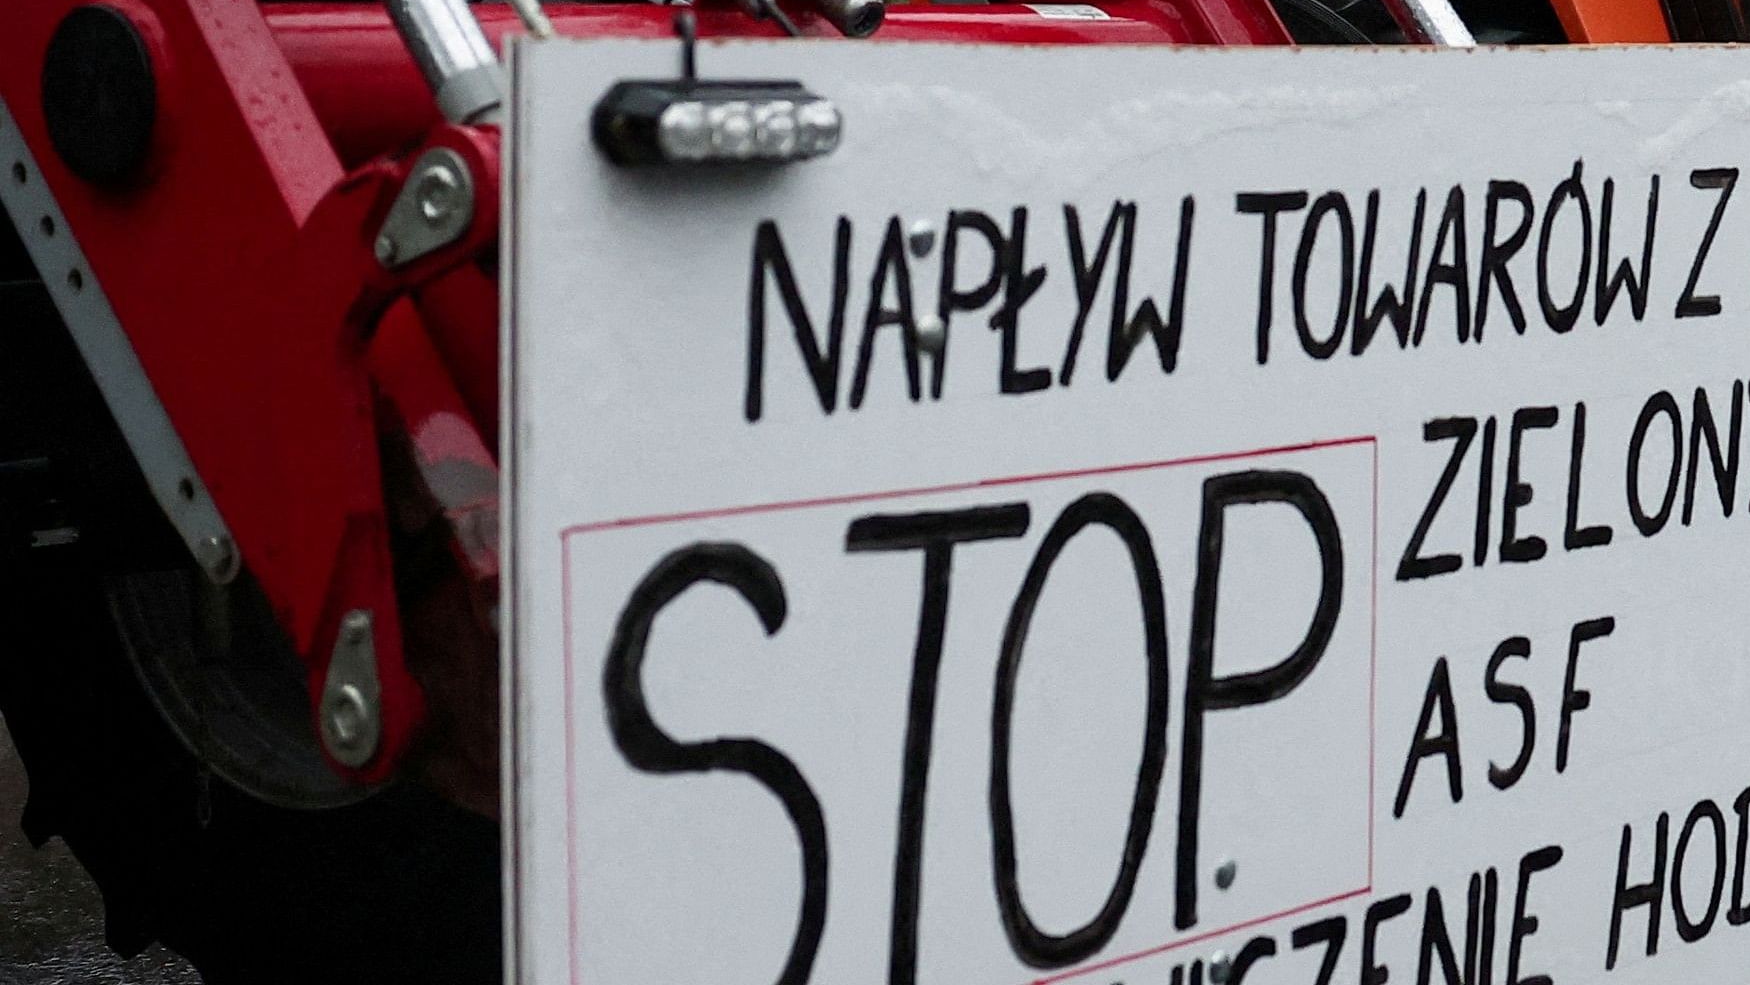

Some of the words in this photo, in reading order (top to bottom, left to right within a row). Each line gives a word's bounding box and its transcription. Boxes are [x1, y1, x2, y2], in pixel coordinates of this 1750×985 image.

[745, 195, 1195, 422] NAPŁYW
[1236, 158, 1660, 365] TOWARÓW
[1675, 167, 1740, 319] Z
[602, 469, 1344, 985] STOP
[1393, 616, 1616, 819] ASF
